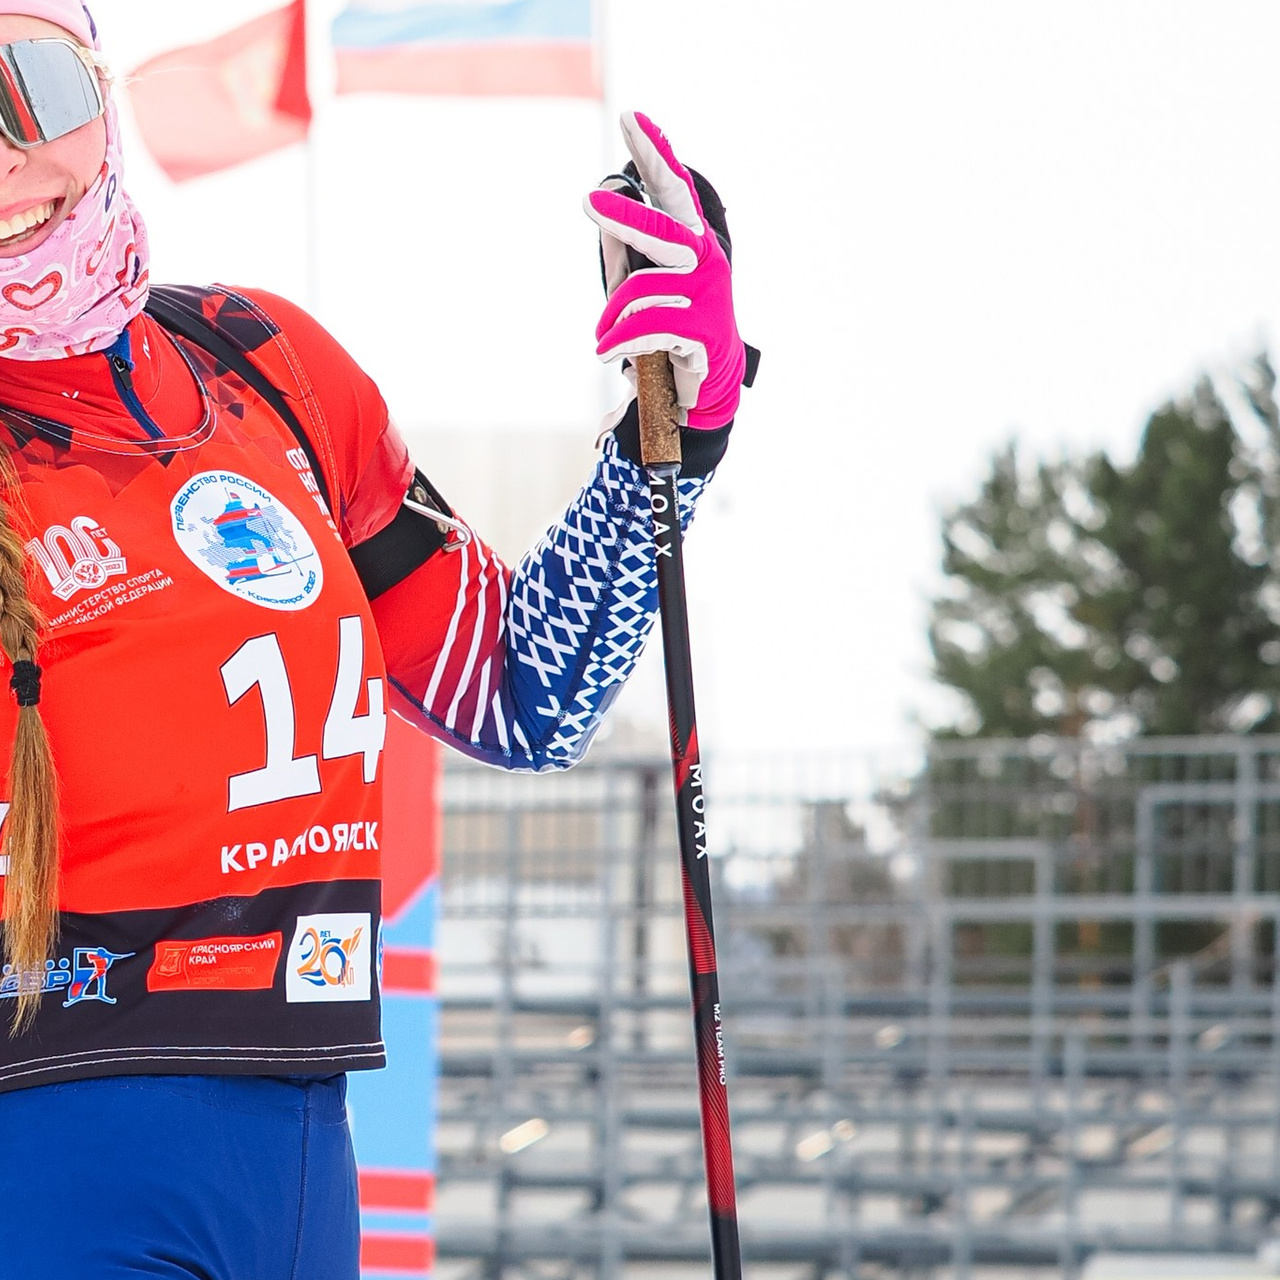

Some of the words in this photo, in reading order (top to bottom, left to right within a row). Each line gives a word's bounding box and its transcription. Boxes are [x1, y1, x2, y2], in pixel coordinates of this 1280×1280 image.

[219, 474, 272, 503] РОССИИ
[126, 568, 164, 588] СПОРТА
[114, 576, 175, 606] ФЕДЕРАЦИИ
[219, 615, 387, 814] 14
[190, 938, 276, 954] КРАСНОЯРСКИЙ
[188, 954, 217, 965] КРАЙ
